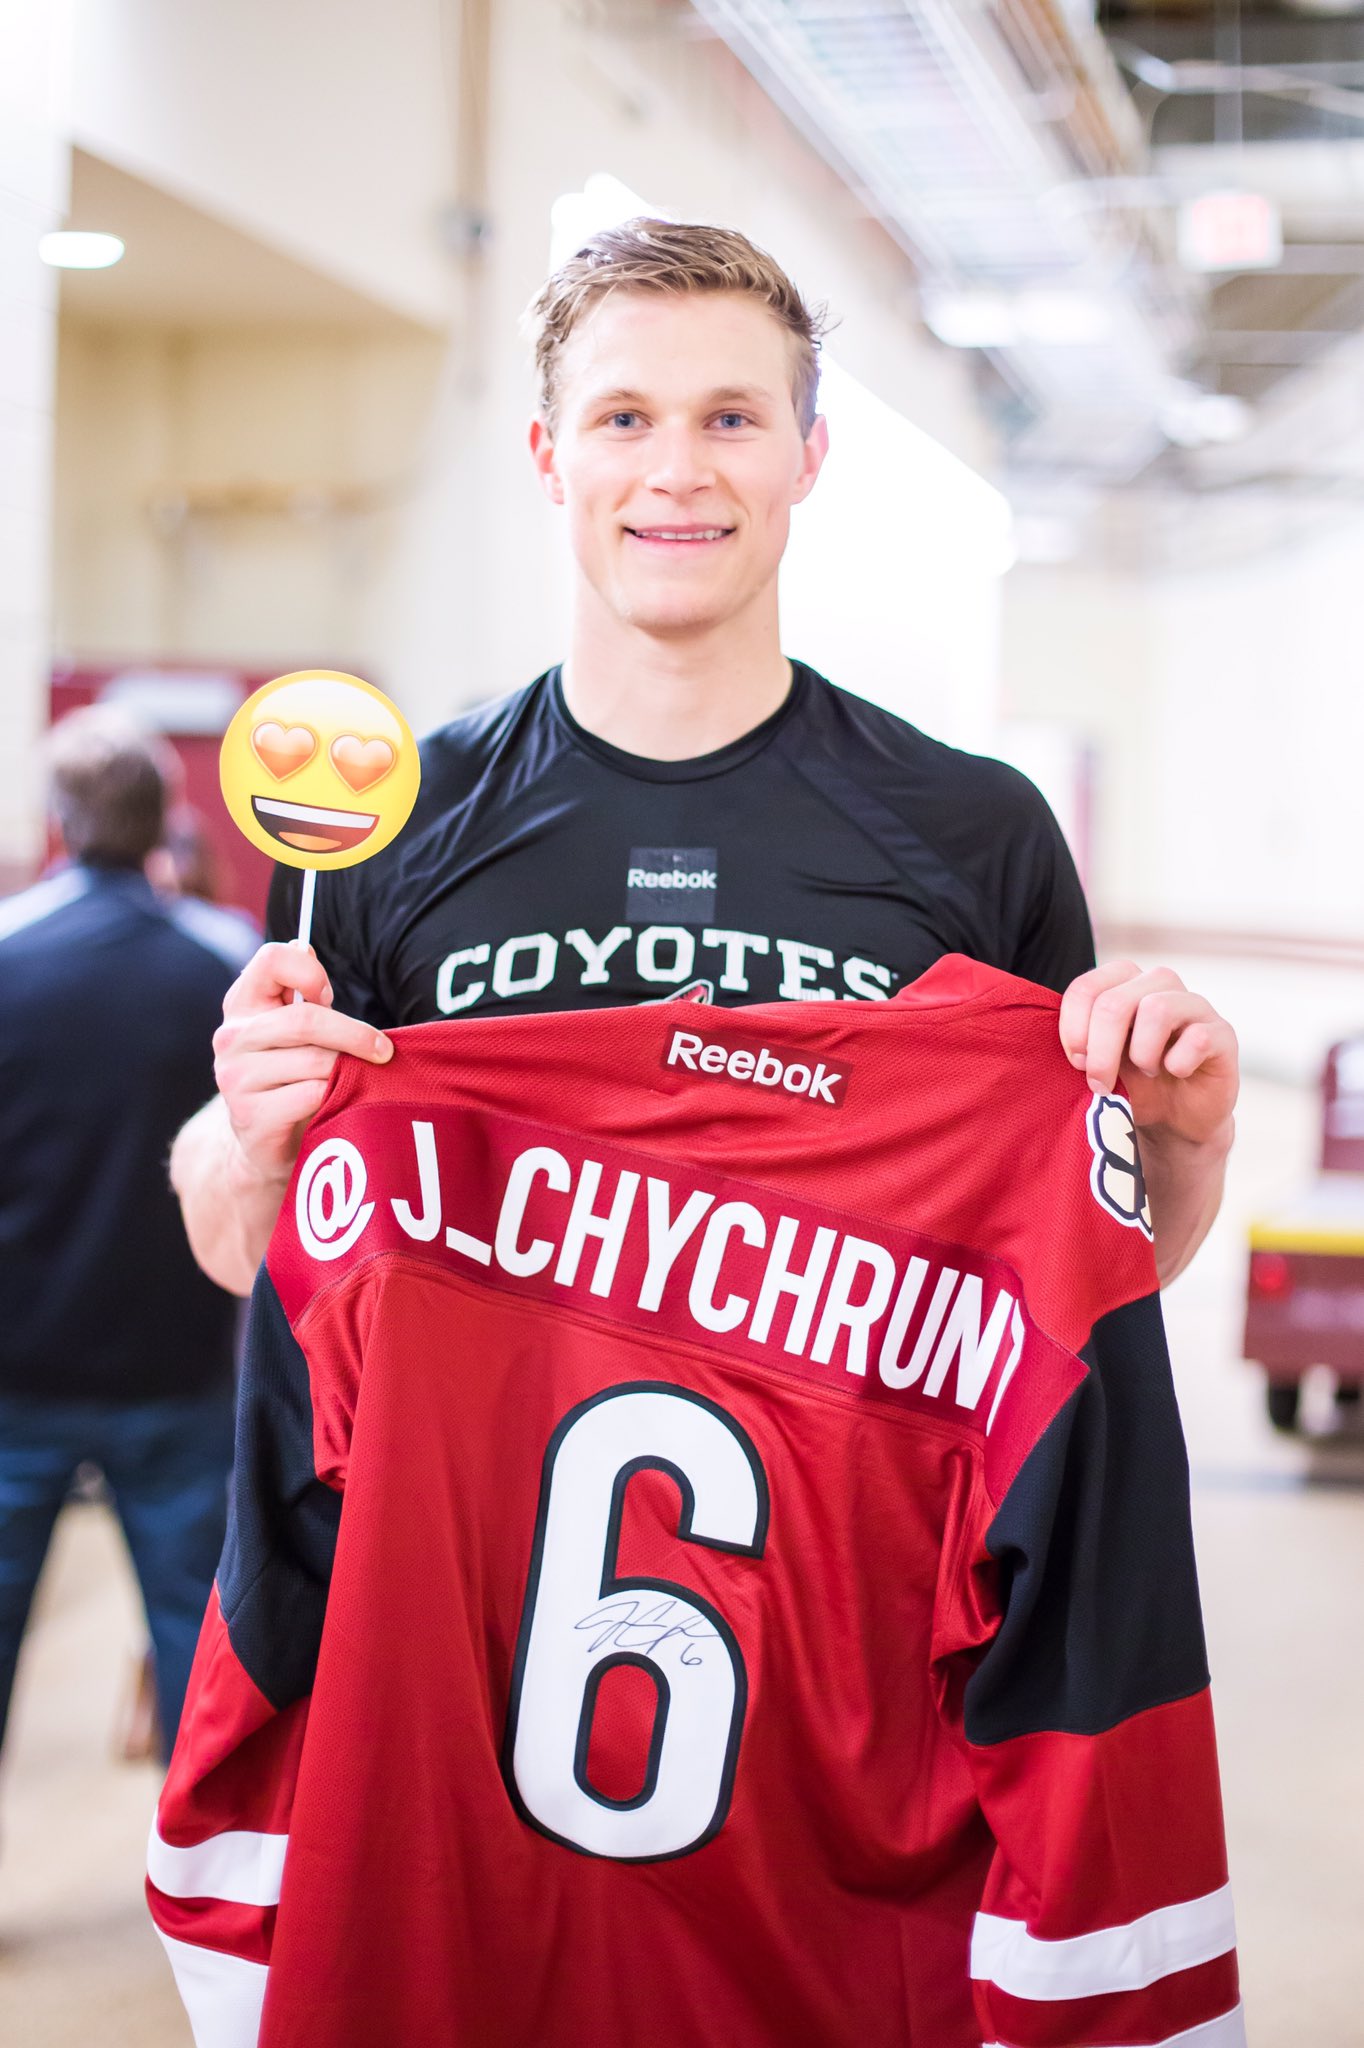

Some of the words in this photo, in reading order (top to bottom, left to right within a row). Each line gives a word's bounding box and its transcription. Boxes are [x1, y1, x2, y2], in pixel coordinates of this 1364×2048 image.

[627, 867, 718, 890] Reebok
[436, 925, 892, 1015] COYOTES
[666, 1030, 843, 1104] Reebok
[502, 1380, 771, 1865] 6
